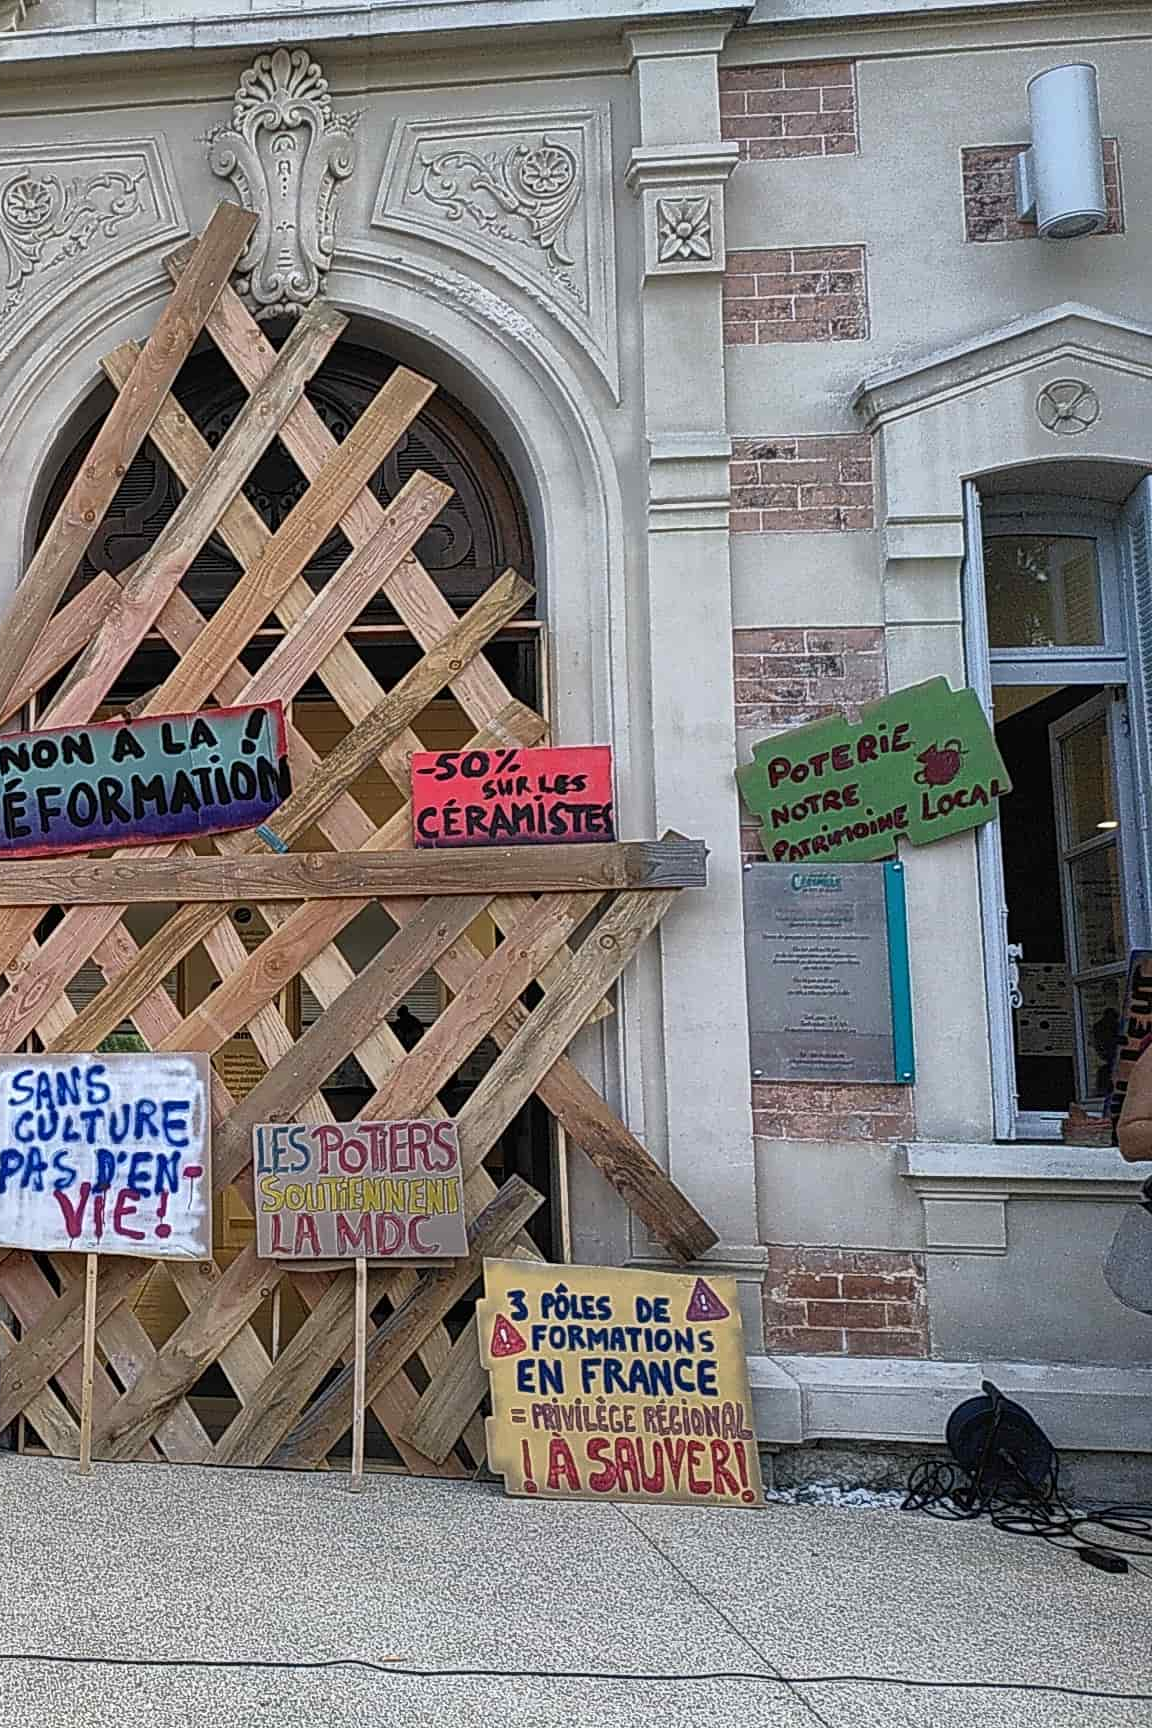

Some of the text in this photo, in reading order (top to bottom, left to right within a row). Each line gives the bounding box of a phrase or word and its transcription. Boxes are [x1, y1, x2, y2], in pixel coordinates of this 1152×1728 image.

[111, 719, 145, 763] À
[161, 717, 218, 756] LA
[767, 723, 916, 788] POTERIE
[482, 774, 588, 800] SUR LES
[770, 784, 860, 829] NOTRE
[416, 796, 613, 840] CÉRAMISTES
[772, 778, 1009, 863] PATRIMOINE LOCAL
[8, 1064, 110, 1110] SANS
[14, 1099, 190, 1147] CULTURE
[257, 1121, 458, 1175] LES POTIERS
[260, 1175, 460, 1214] SOUTIENNENT
[271, 1212, 440, 1256] LA MDC
[507, 1283, 671, 1323] 3 PÔLES DE
[532, 1325, 715, 1352] FORMATIONS
[517, 1359, 718, 1395] EN FRANCE
[532, 1397, 636, 1433] PRIVILÈGE
[643, 1399, 753, 1440] RÉGIONAL
[547, 1432, 581, 1491] À
